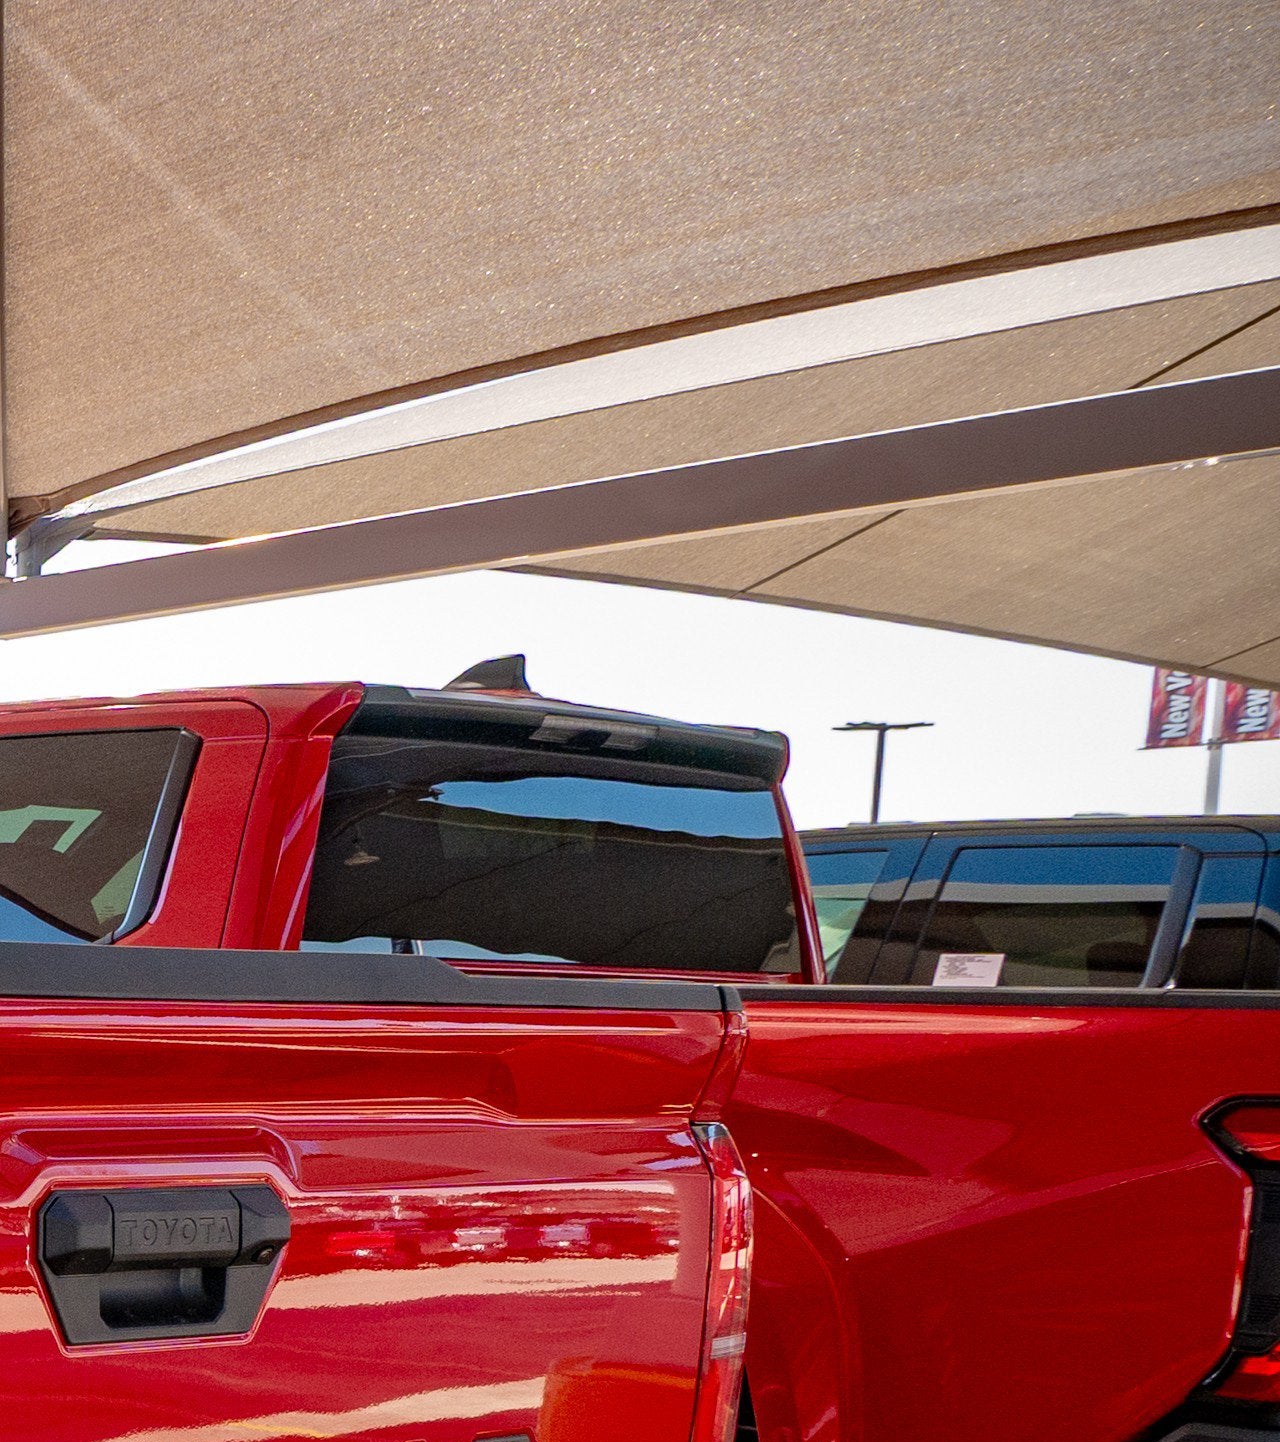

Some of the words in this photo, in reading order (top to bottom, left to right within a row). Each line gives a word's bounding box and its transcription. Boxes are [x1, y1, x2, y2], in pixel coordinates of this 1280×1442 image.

[1160, 694, 1191, 739] New
[1237, 690, 1270, 733] New
[120, 1216, 235, 1248] TOYOTA
